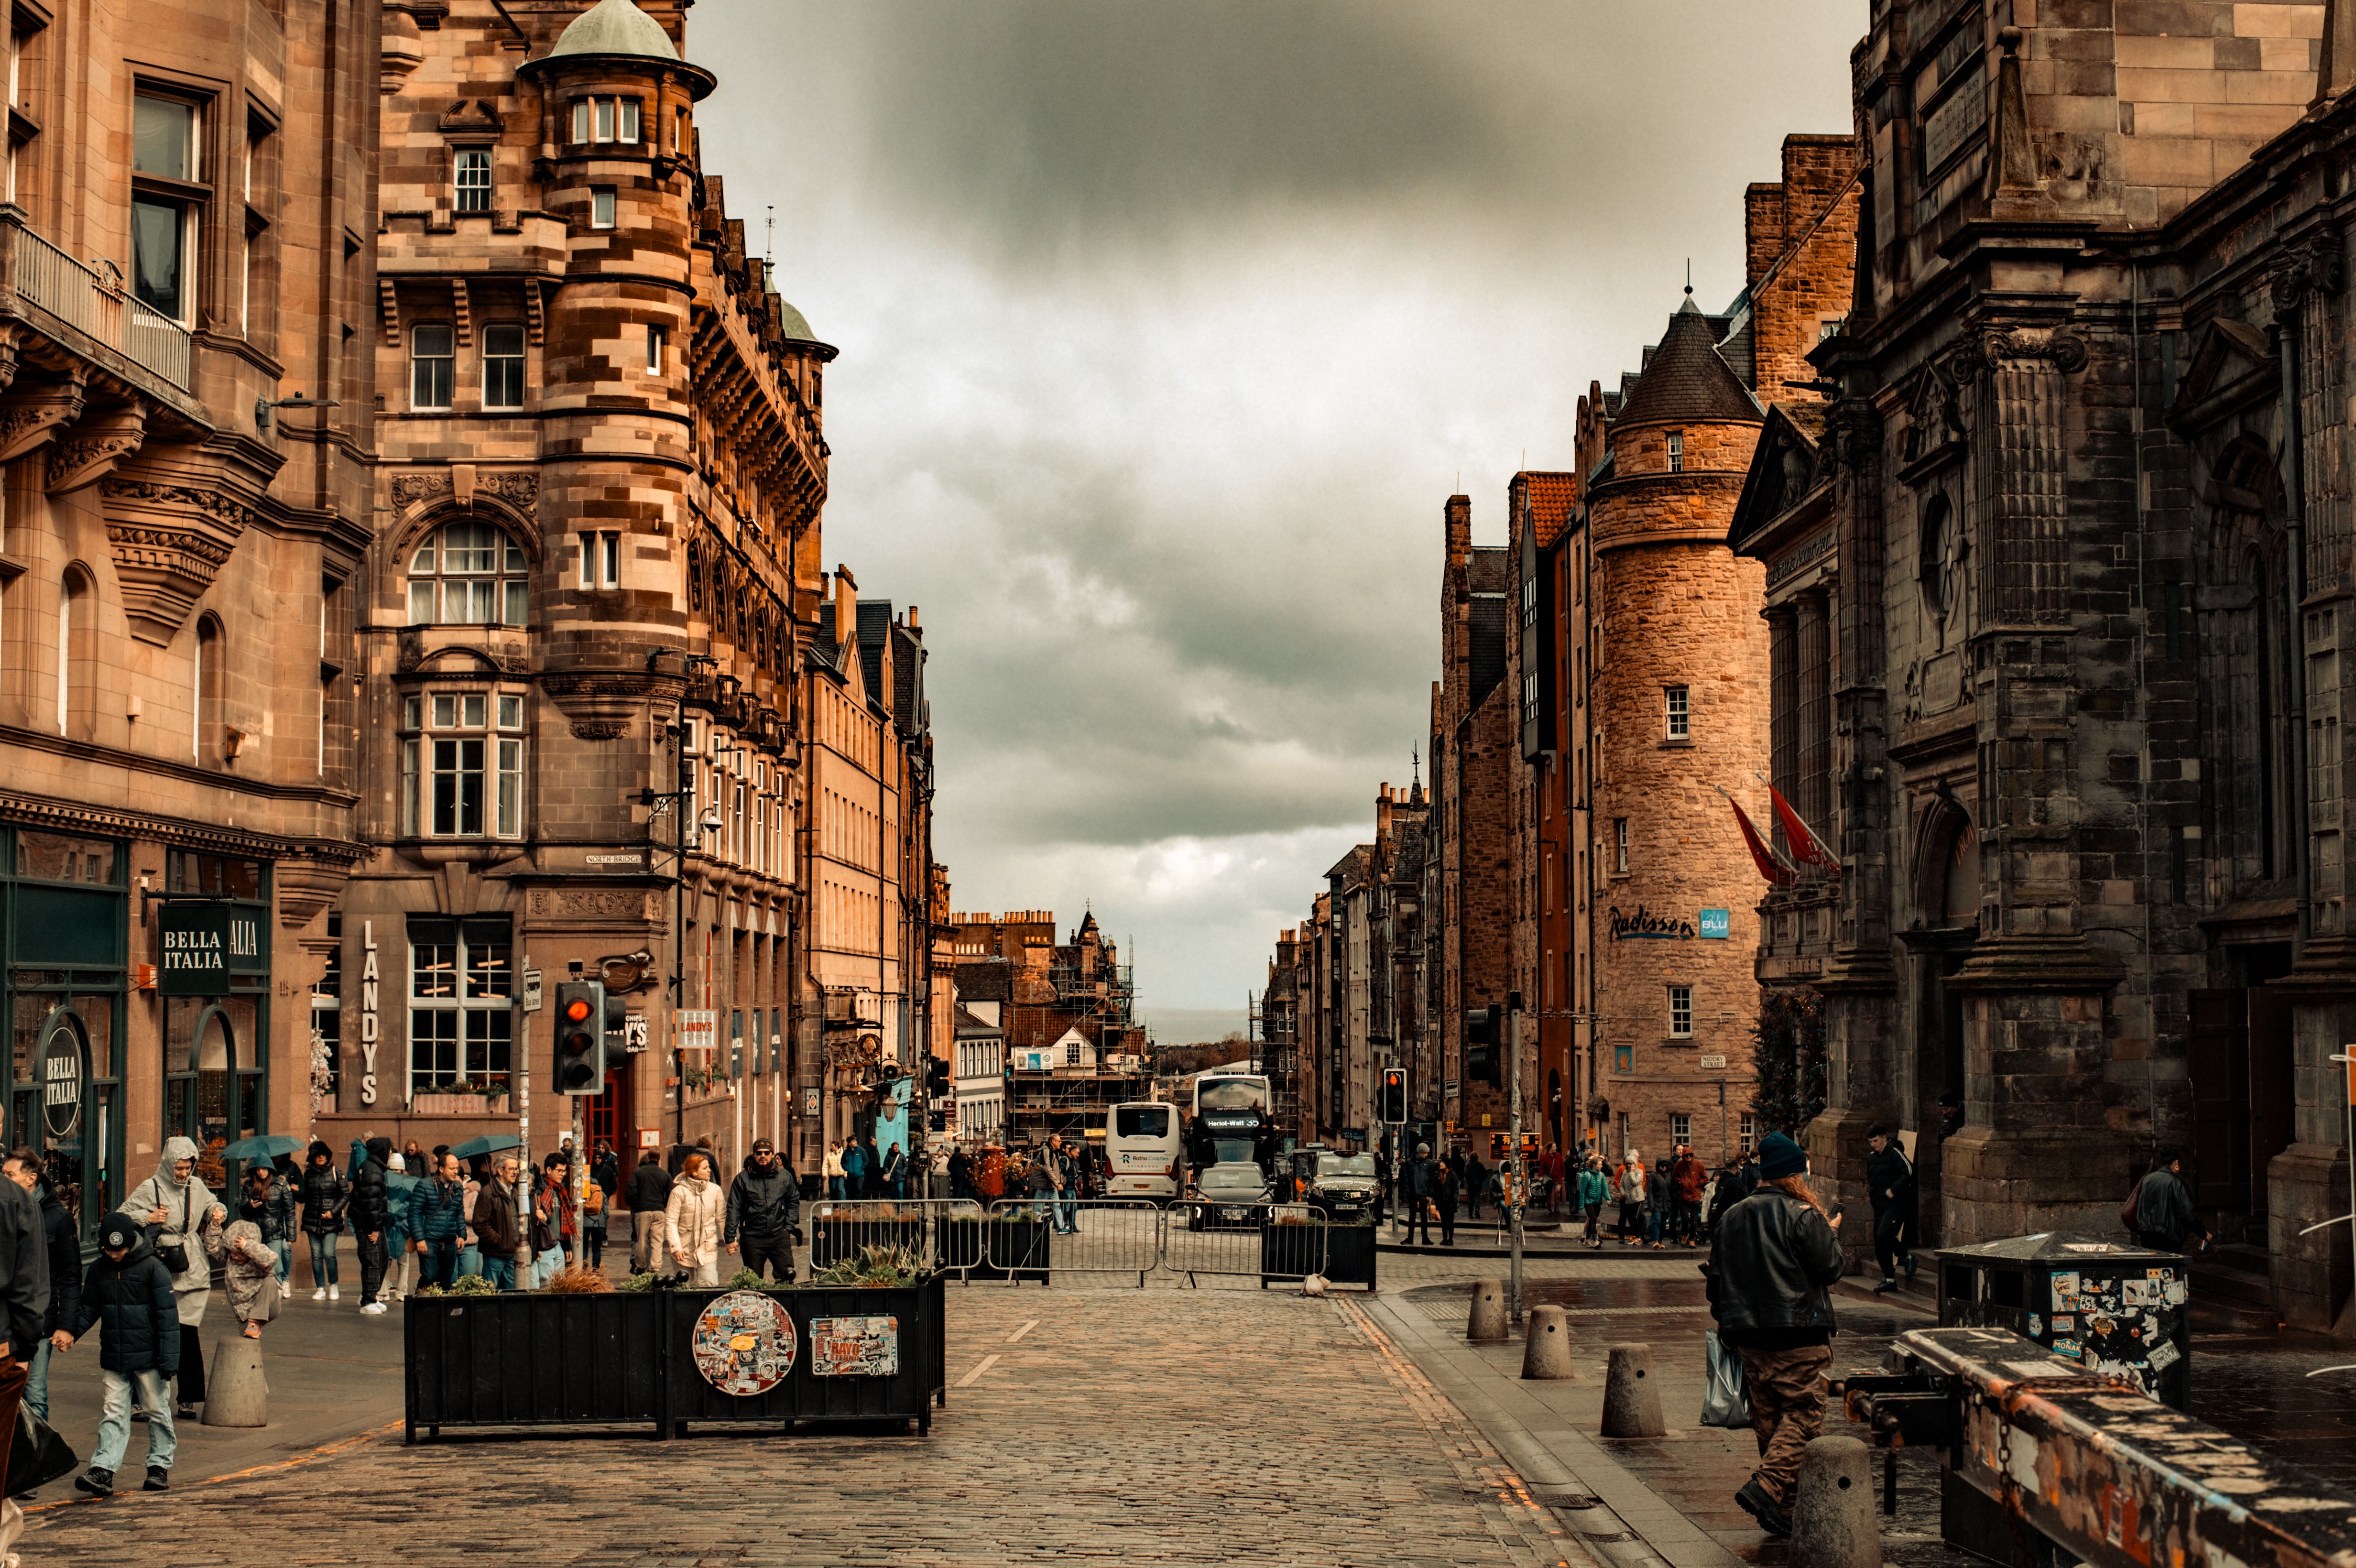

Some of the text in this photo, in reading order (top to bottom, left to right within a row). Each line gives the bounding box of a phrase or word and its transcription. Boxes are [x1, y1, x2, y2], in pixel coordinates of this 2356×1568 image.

[1610, 904, 1727, 941] Radisson BLU
[164, 931, 221, 948] BELLA
[229, 920, 257, 956] ALIA
[164, 952, 223, 969] ITALIA
[681, 1021, 712, 1032] LANDY'S
[47, 1056, 76, 1080] BELLA
[46, 1081, 76, 1106] ITALIA
[831, 1342, 860, 1355] RAYO
